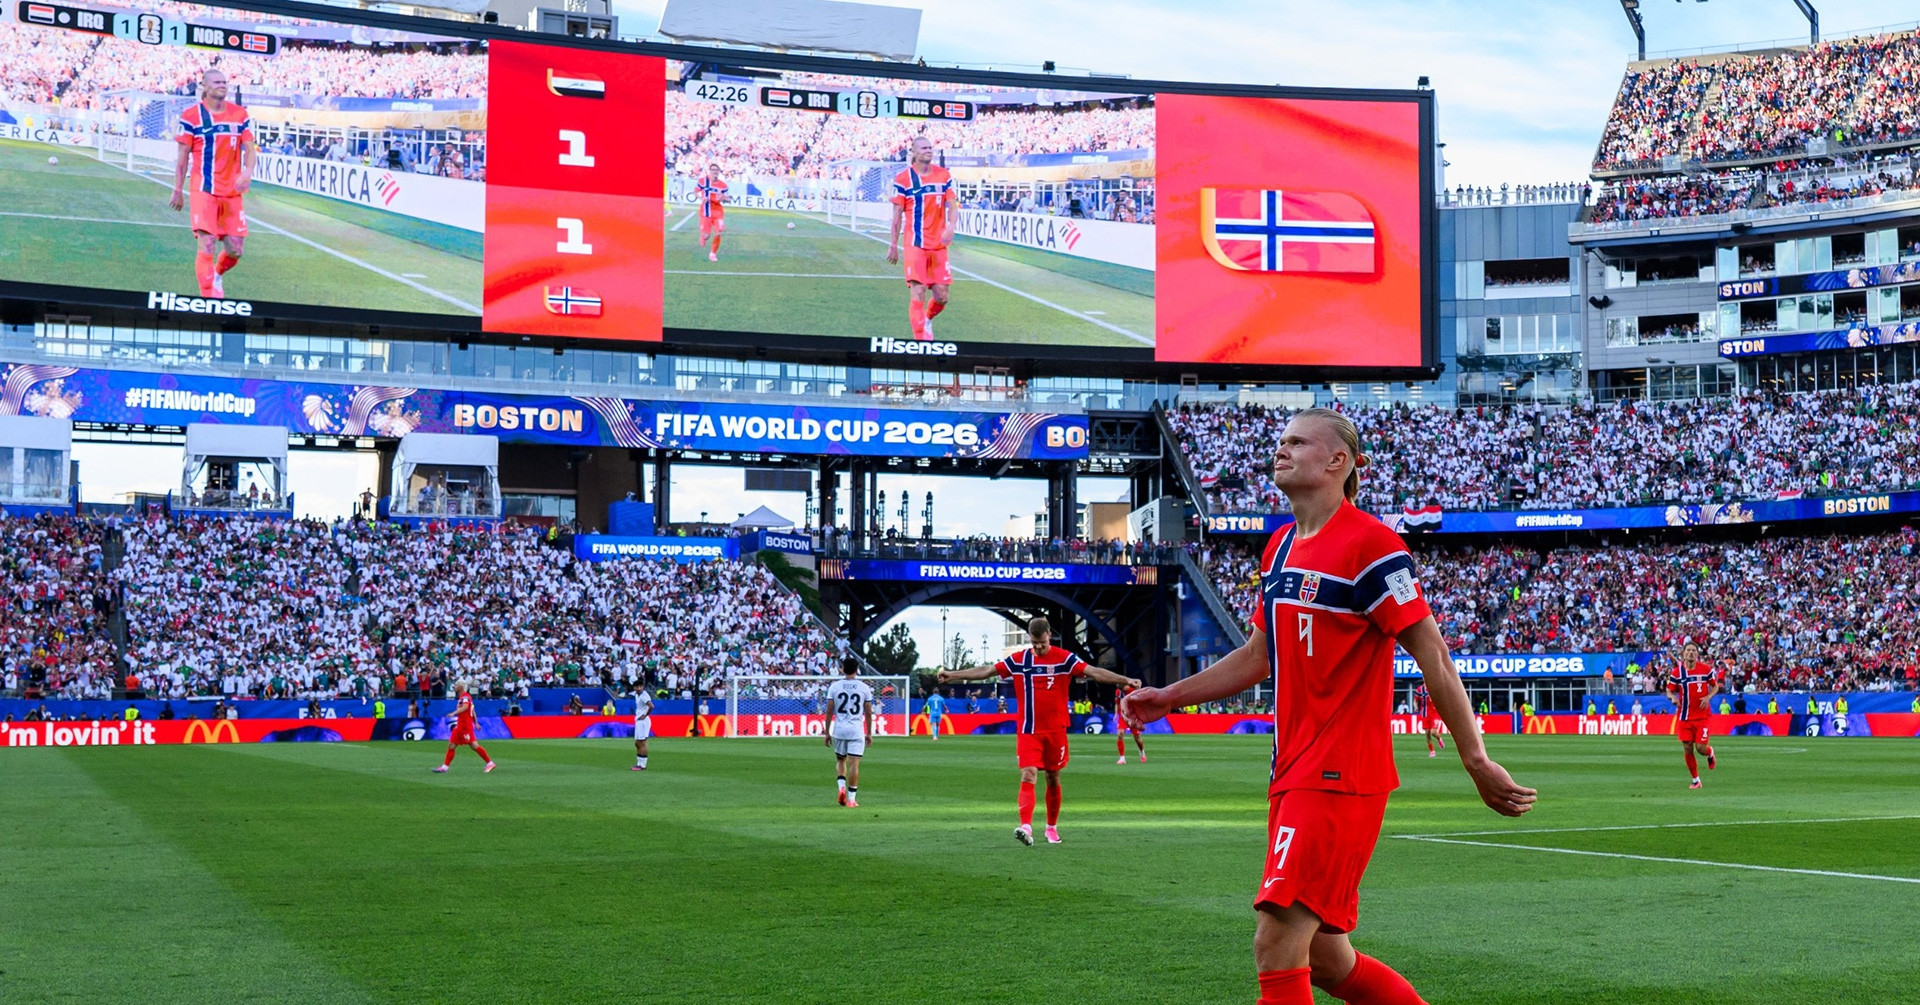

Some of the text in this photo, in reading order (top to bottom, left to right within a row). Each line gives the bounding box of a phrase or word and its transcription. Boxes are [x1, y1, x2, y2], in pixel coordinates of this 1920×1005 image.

[77, 11, 225, 46] IRQ 1 1 NOR
[696, 84, 748, 102] 42:26
[808, 92, 929, 116] IRQ 1 1 NOR
[559, 129, 595, 167] 1
[276, 158, 291, 184] OF
[295, 162, 371, 203] AMERICA
[557, 217, 592, 255] 1
[974, 213, 988, 235] OF
[991, 216, 1056, 249] AMERICA
[1719, 281, 1764, 297] STON
[148, 291, 252, 316] Hisense
[870, 336, 958, 356] Hisense
[1720, 339, 1765, 355] STON
[125, 388, 255, 417] #FIFAWorldCup
[454, 404, 583, 432] BOSTON
[656, 412, 978, 445] FIFA WORLD CUP 2026
[1046, 426, 1089, 448] BO
[1824, 495, 1889, 515] BOSTON
[1516, 514, 1583, 527] #FIFAWorldCup
[592, 543, 723, 556] FIFA WORLD CUP 2026
[765, 535, 810, 551] BOSTON
[920, 565, 1066, 579] FIFA WORLD CUP 2026
[1298, 612, 1313, 657] 9
[1454, 659, 1489, 673] RLD
[1491, 658, 1526, 673] CUP
[1528, 657, 1584, 673] 2026
[1046, 676, 1055, 690] 7
[298, 707, 338, 720] FFA
[837, 691, 861, 716] 23
[1, 719, 156, 746] 'm lovin' it
[757, 714, 794, 736] i'm
[1579, 714, 1648, 735] i'm lovin' it
[1274, 825, 1297, 870] 9
